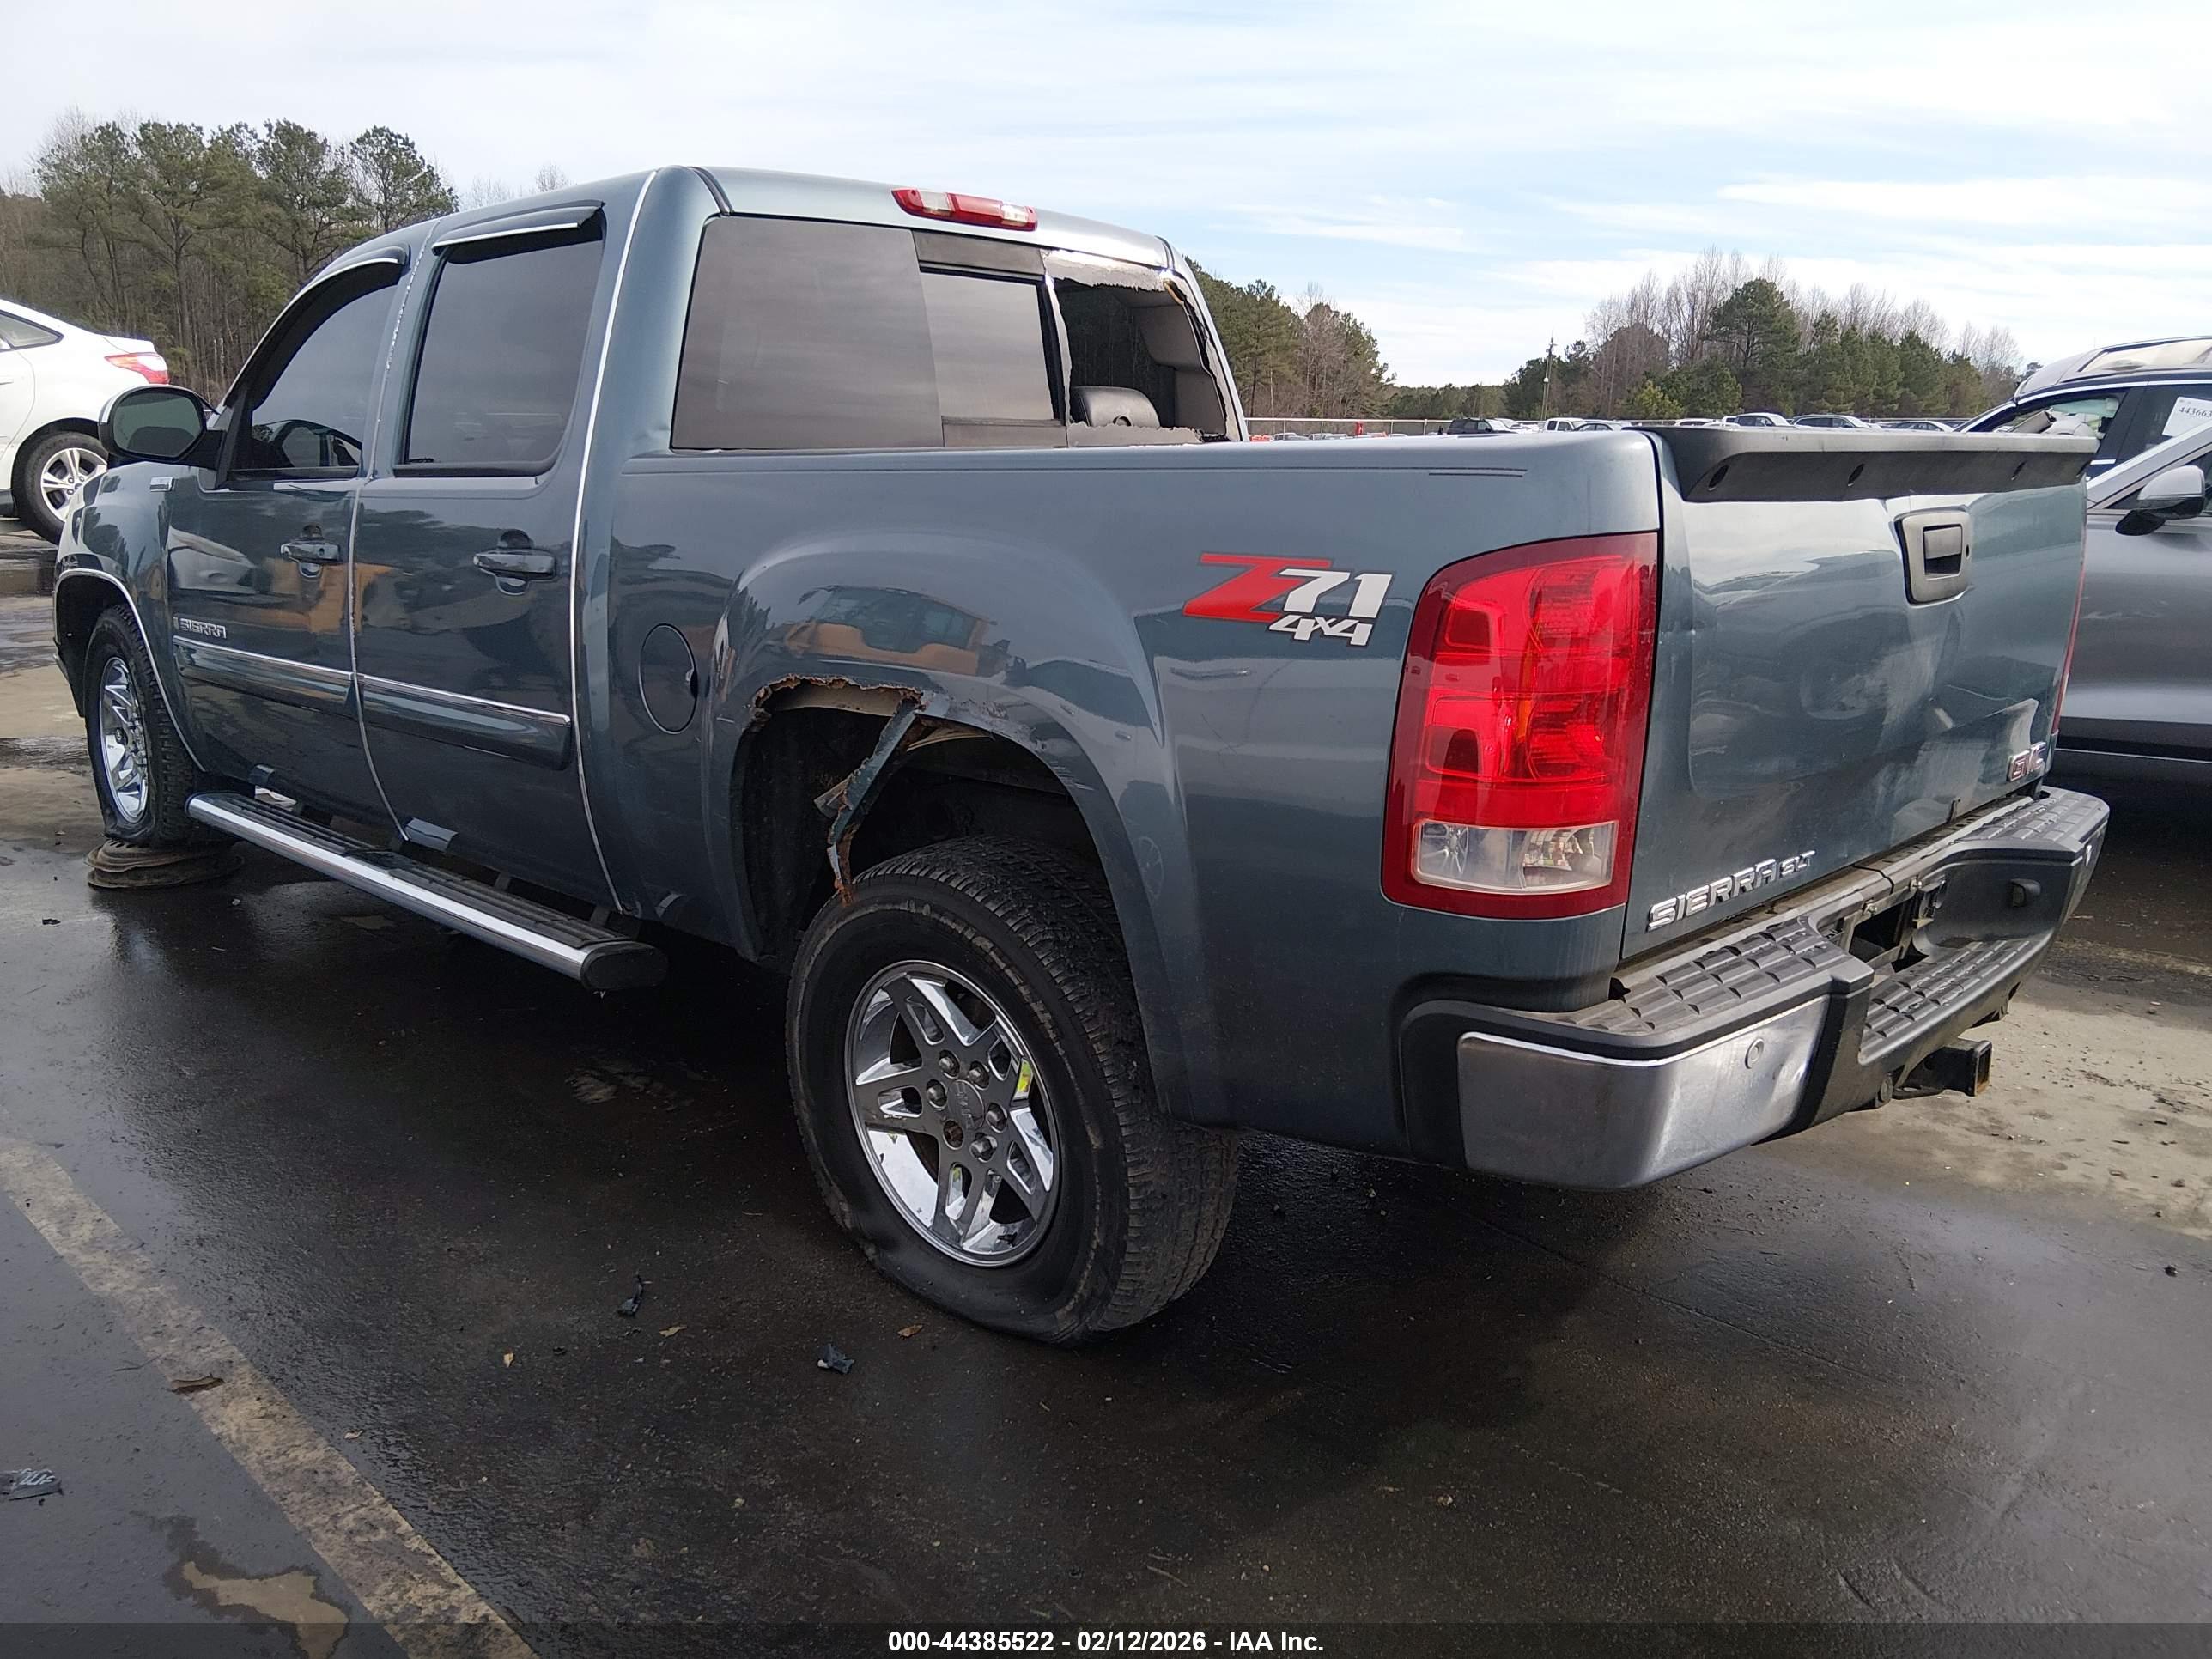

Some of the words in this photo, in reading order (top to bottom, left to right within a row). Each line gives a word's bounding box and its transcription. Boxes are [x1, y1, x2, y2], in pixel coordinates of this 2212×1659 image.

[1182, 552, 1393, 623] Z71
[179, 617, 227, 640] SIERRA
[2008, 742, 2047, 781] GMC
[1647, 858, 1777, 932] SIERRA
[1779, 849, 1816, 878] SLT
